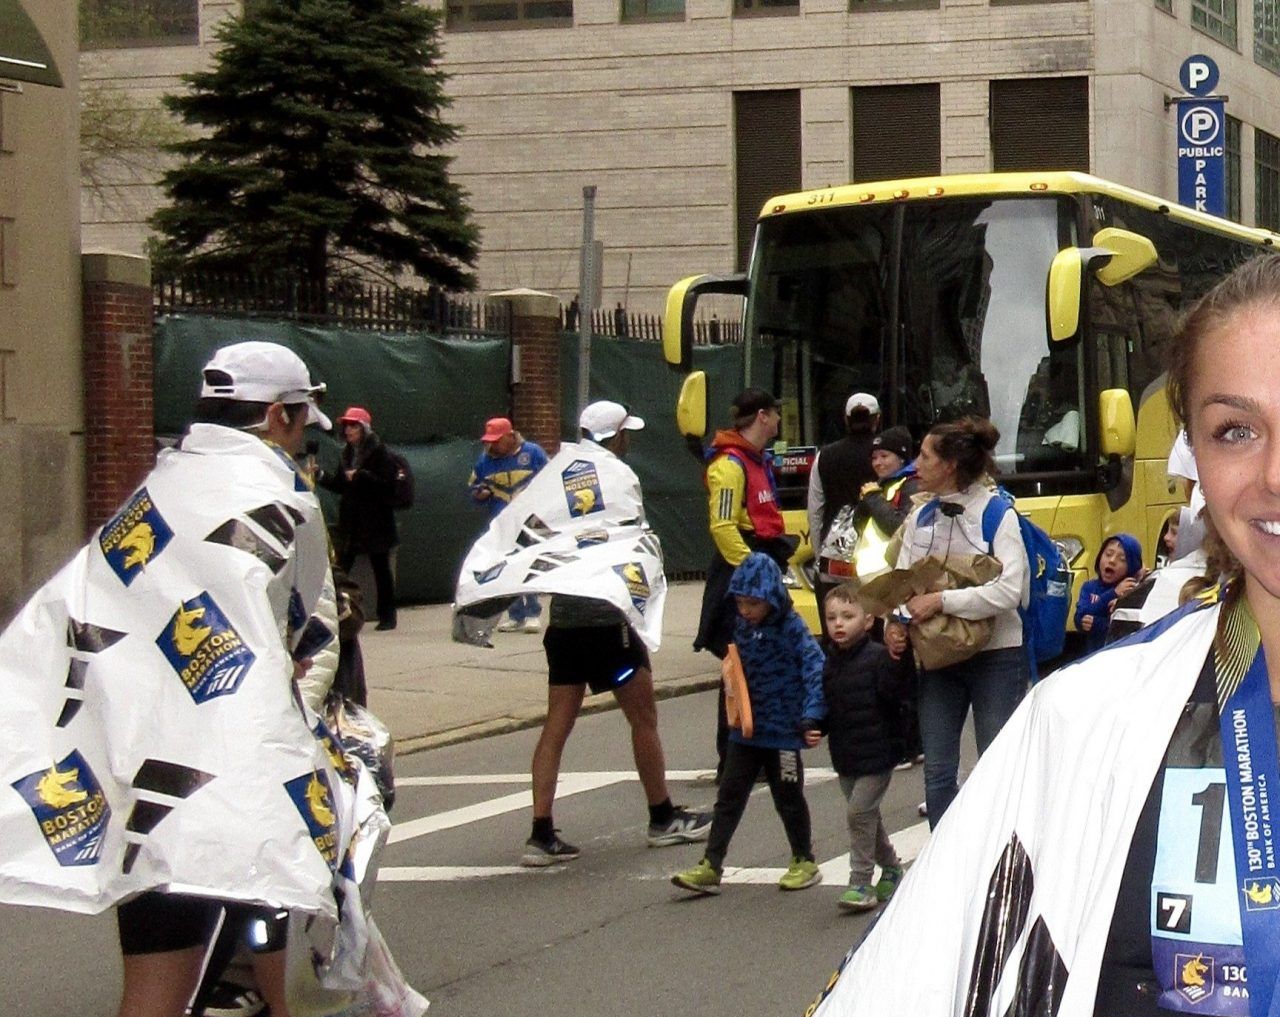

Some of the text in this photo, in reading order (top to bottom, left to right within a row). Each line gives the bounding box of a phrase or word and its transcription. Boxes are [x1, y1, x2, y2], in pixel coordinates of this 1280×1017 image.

[1189, 63, 1210, 89] P
[1191, 113, 1213, 139] P
[1178, 147, 1223, 158] PUBLIC
[808, 192, 835, 205] 311
[181, 629, 237, 681] BOSTON
[1233, 708, 1253, 783] MARATHON
[1241, 785, 1260, 841] BOSTON
[1257, 774, 1275, 869] BANK OF AMERICA
[1162, 898, 1187, 928] 7
